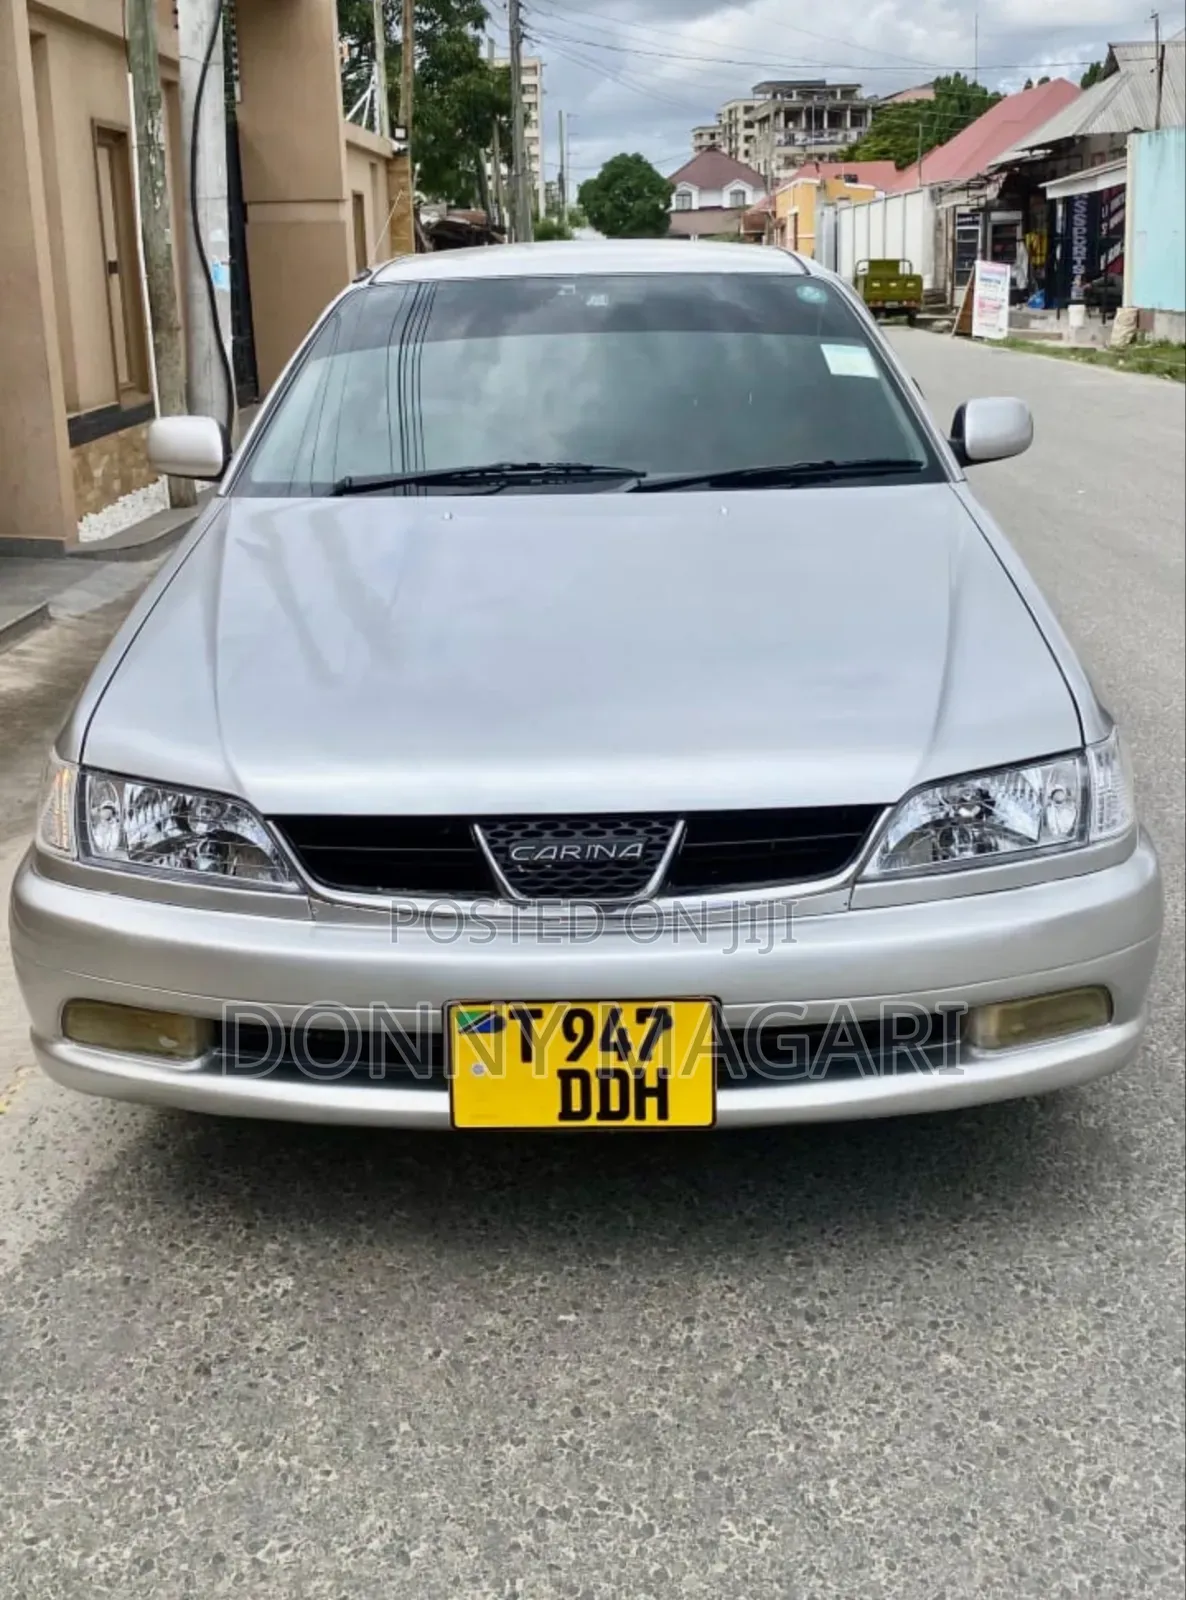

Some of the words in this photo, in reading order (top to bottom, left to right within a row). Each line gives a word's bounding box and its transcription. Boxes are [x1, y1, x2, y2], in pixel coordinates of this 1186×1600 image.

[510, 841, 646, 862] CARINA
[509, 1008, 544, 1063] T
[561, 1007, 673, 1062] 947
[556, 1067, 670, 1121] DDH
